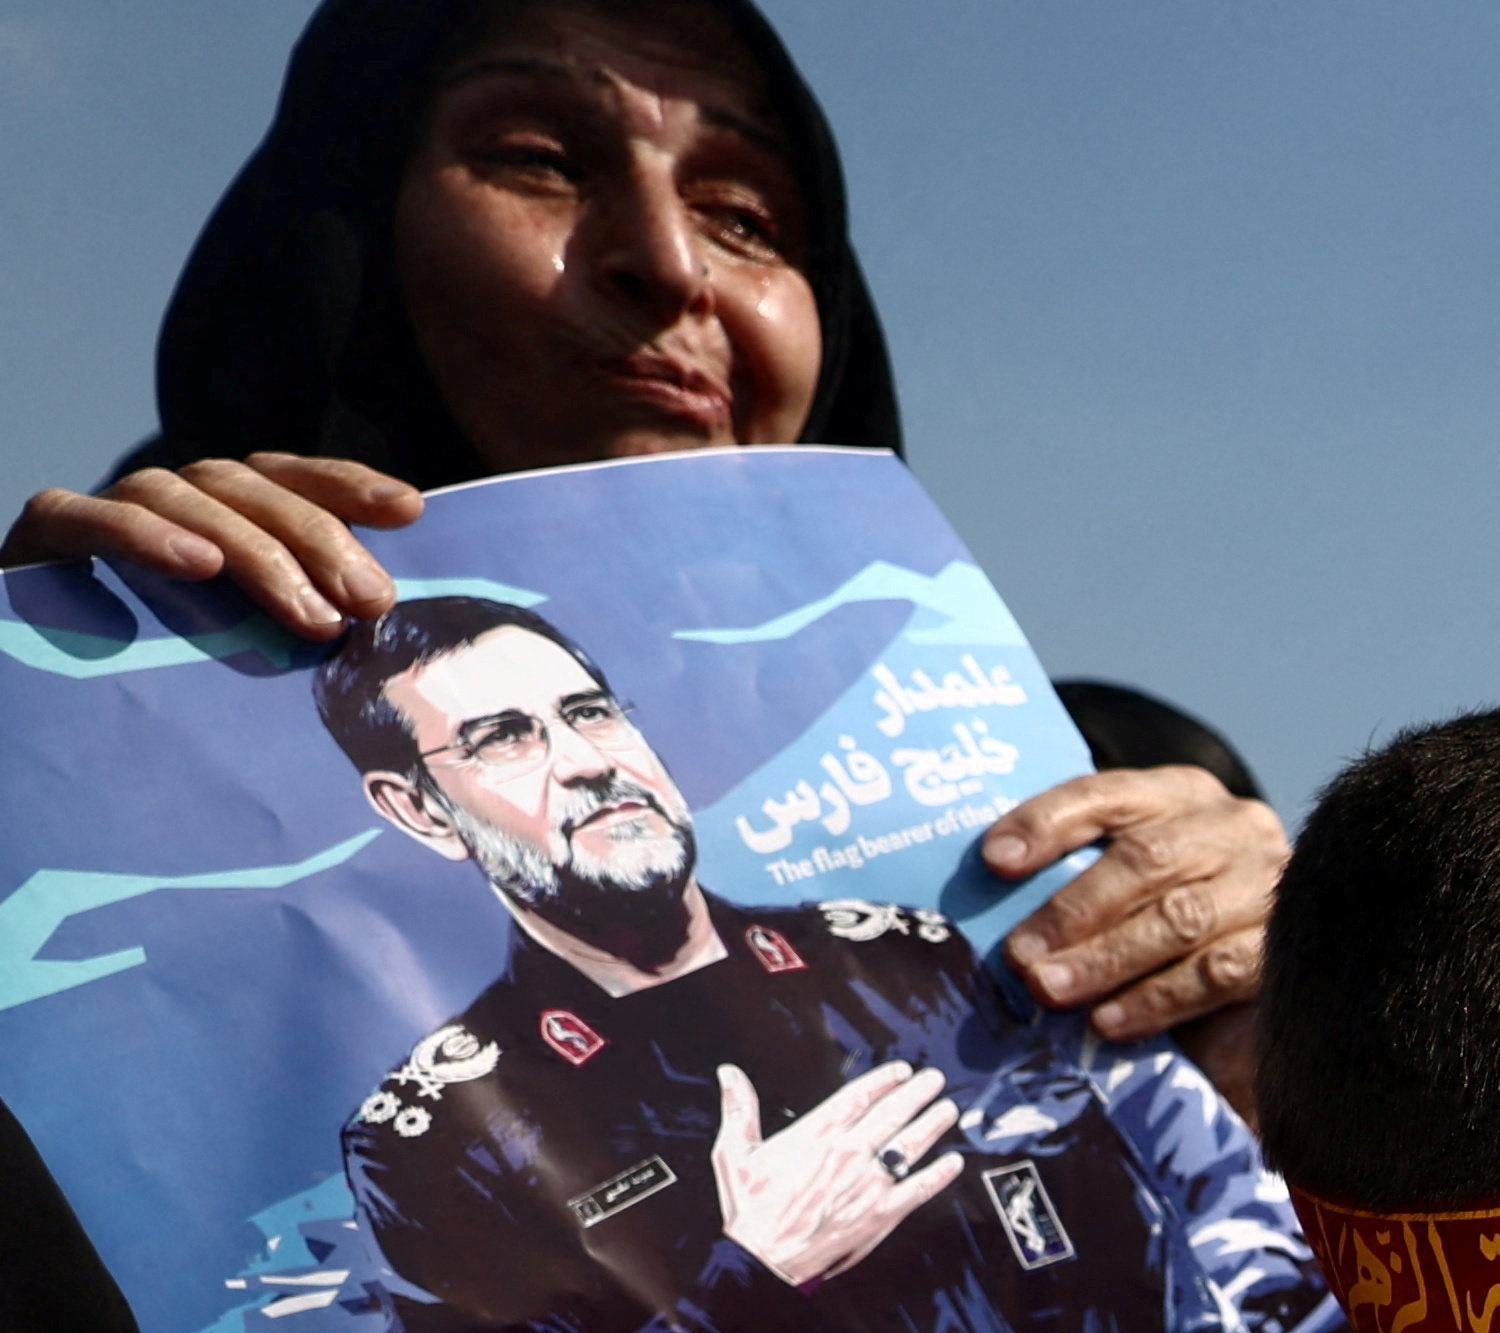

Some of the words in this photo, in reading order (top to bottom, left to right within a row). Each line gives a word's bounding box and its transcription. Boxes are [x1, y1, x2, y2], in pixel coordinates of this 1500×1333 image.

[872, 654, 1028, 737] علمدار
[735, 733, 893, 854] فارس
[892, 717, 1019, 807] خلیج
[765, 858, 814, 886] The
[812, 843, 864, 869] flag
[857, 821, 934, 859] bearer
[934, 808, 960, 837] of
[957, 803, 997, 832] the
